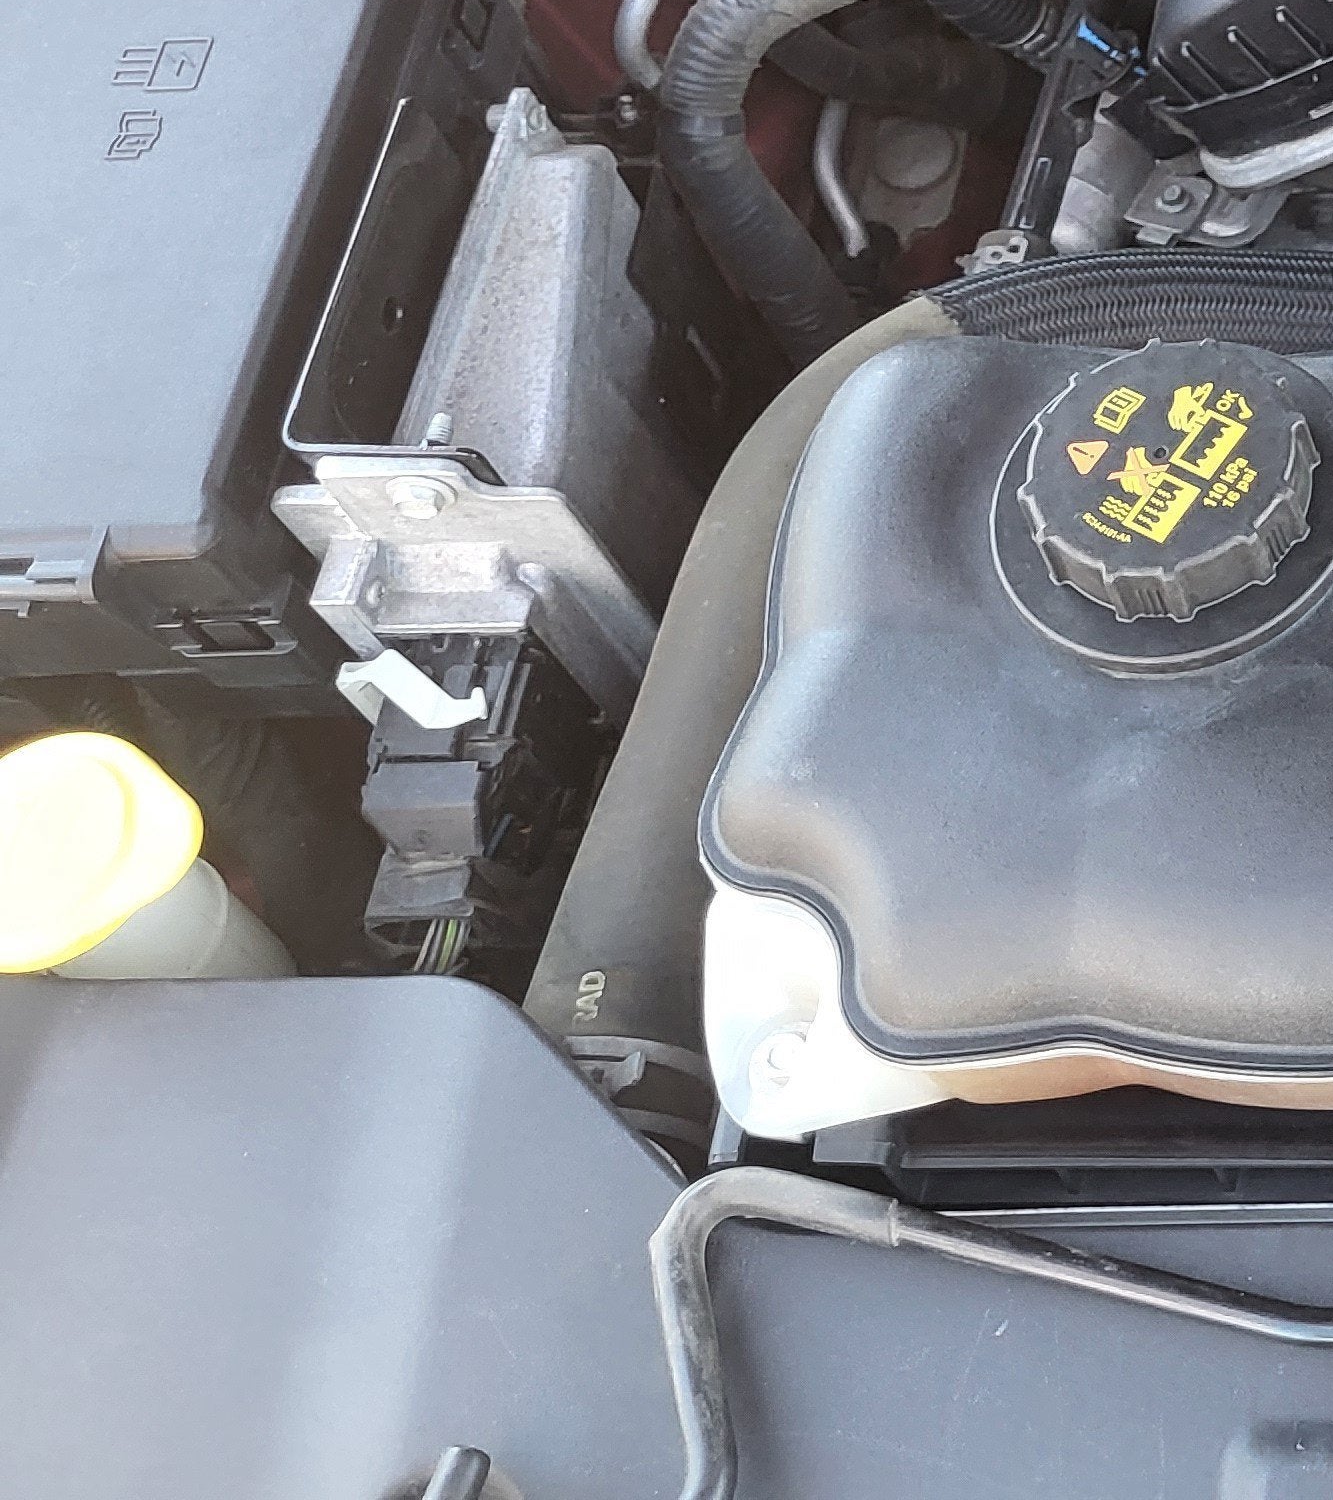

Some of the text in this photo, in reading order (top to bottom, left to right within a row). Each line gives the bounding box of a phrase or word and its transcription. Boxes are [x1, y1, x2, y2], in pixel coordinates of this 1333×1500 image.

[1215, 389, 1241, 412] OK
[1202, 481, 1229, 507] 110
[1221, 466, 1258, 508] 16 psi
[572, 970, 606, 1024] RAD
